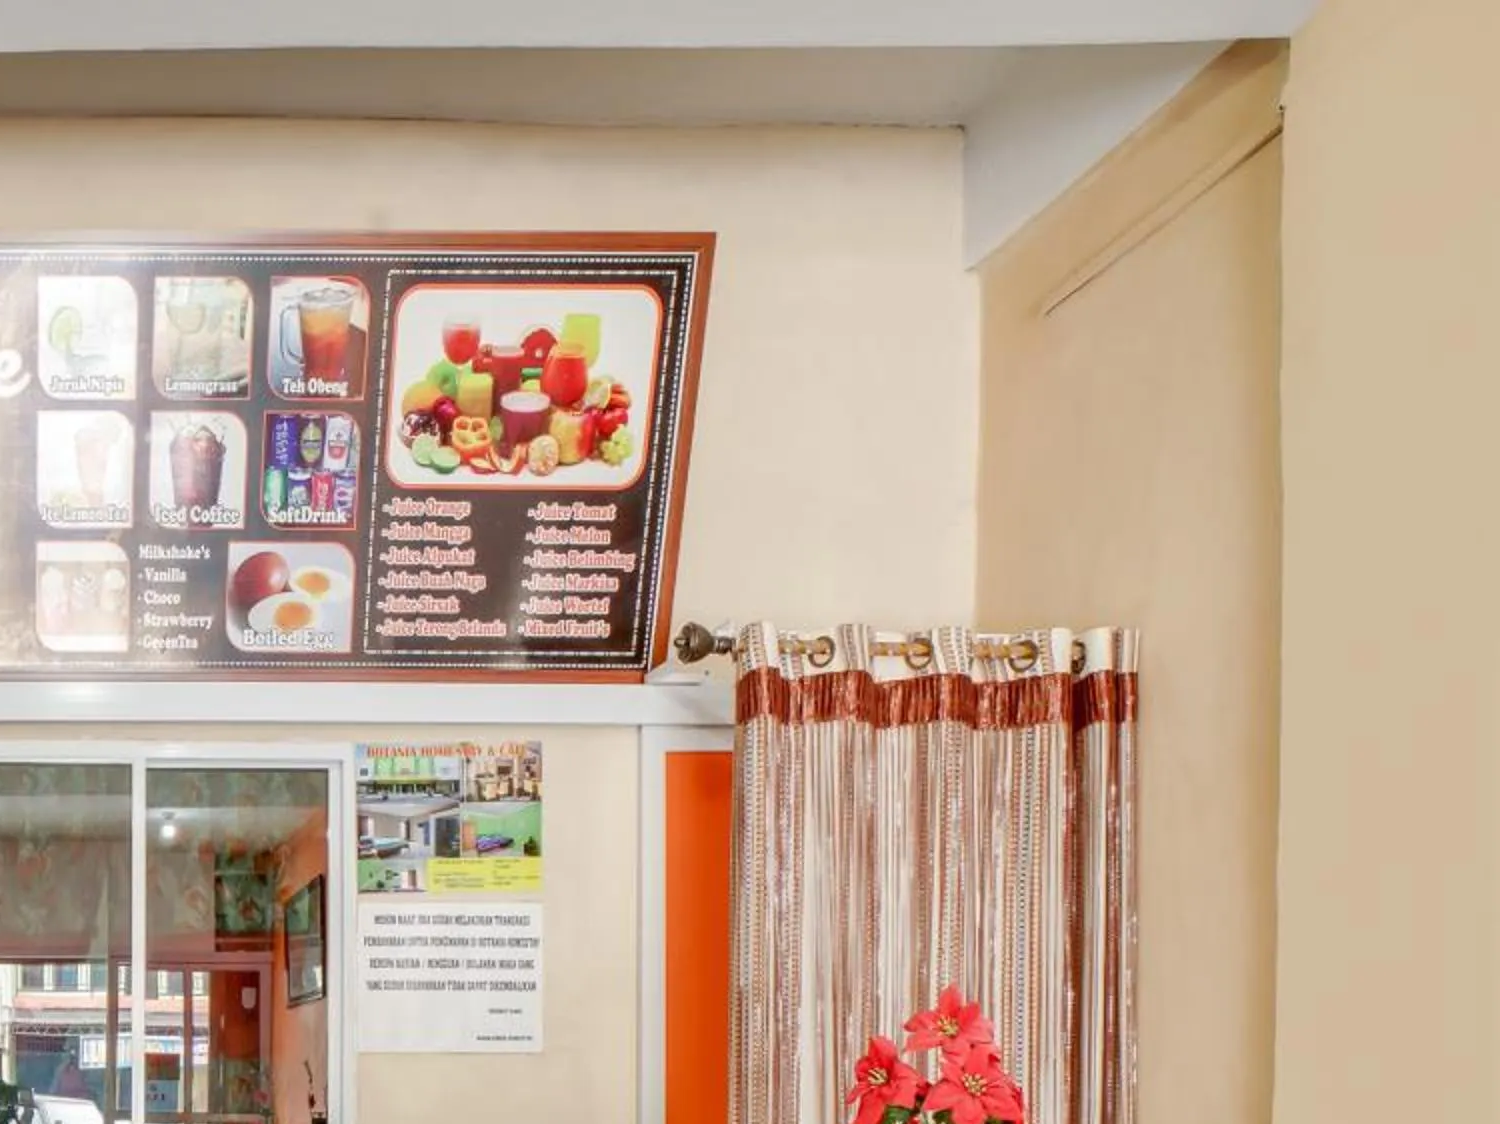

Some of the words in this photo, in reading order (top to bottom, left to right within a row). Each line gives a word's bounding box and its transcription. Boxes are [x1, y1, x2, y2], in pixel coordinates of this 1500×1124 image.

[281, 376, 306, 393] Teh
[307, 376, 348, 397] Obeng
[189, 503, 245, 523] Coffee
[143, 566, 188, 583] Vanilla
[142, 590, 182, 605] Choco
[142, 611, 214, 630] Strawberry
[243, 629, 298, 646] Boiled
